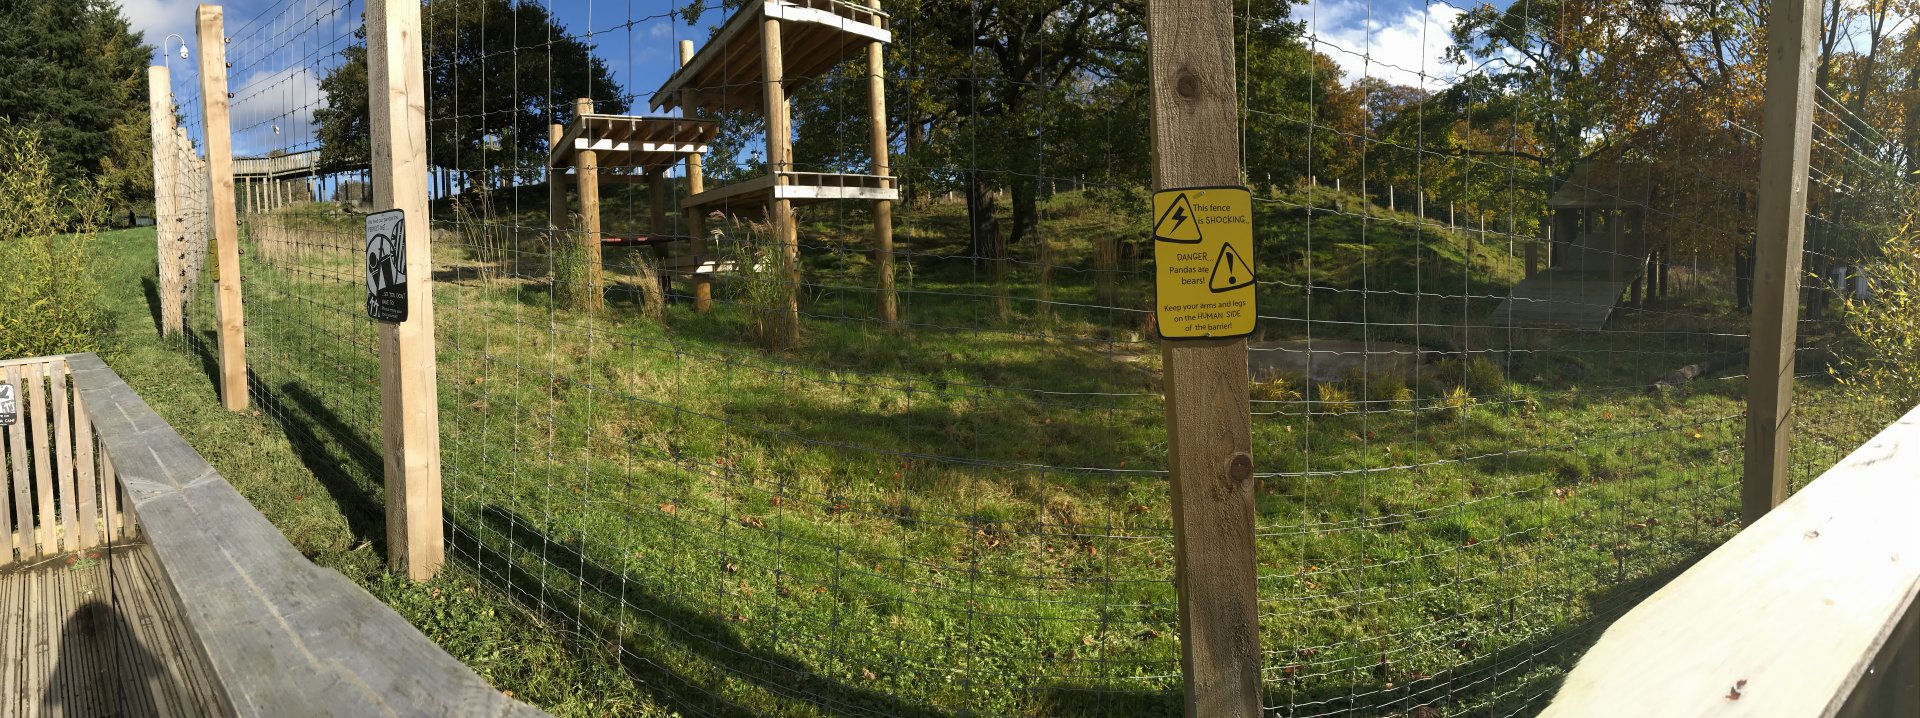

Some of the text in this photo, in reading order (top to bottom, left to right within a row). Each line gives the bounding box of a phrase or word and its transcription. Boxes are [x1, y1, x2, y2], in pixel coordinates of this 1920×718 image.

[1193, 204, 1231, 212] This fence
[1169, 266, 1209, 274] Pandas are
[1181, 276, 1205, 285] bears!
[1164, 304, 1182, 312] Keep
[1183, 303, 1198, 312] your
[1218, 300, 1231, 308] and
[1232, 299, 1246, 307] legs
[1197, 311, 1223, 320] HUMAN
[1226, 309, 1240, 318] SIDE
[1185, 321, 1232, 332] of the barrier!
